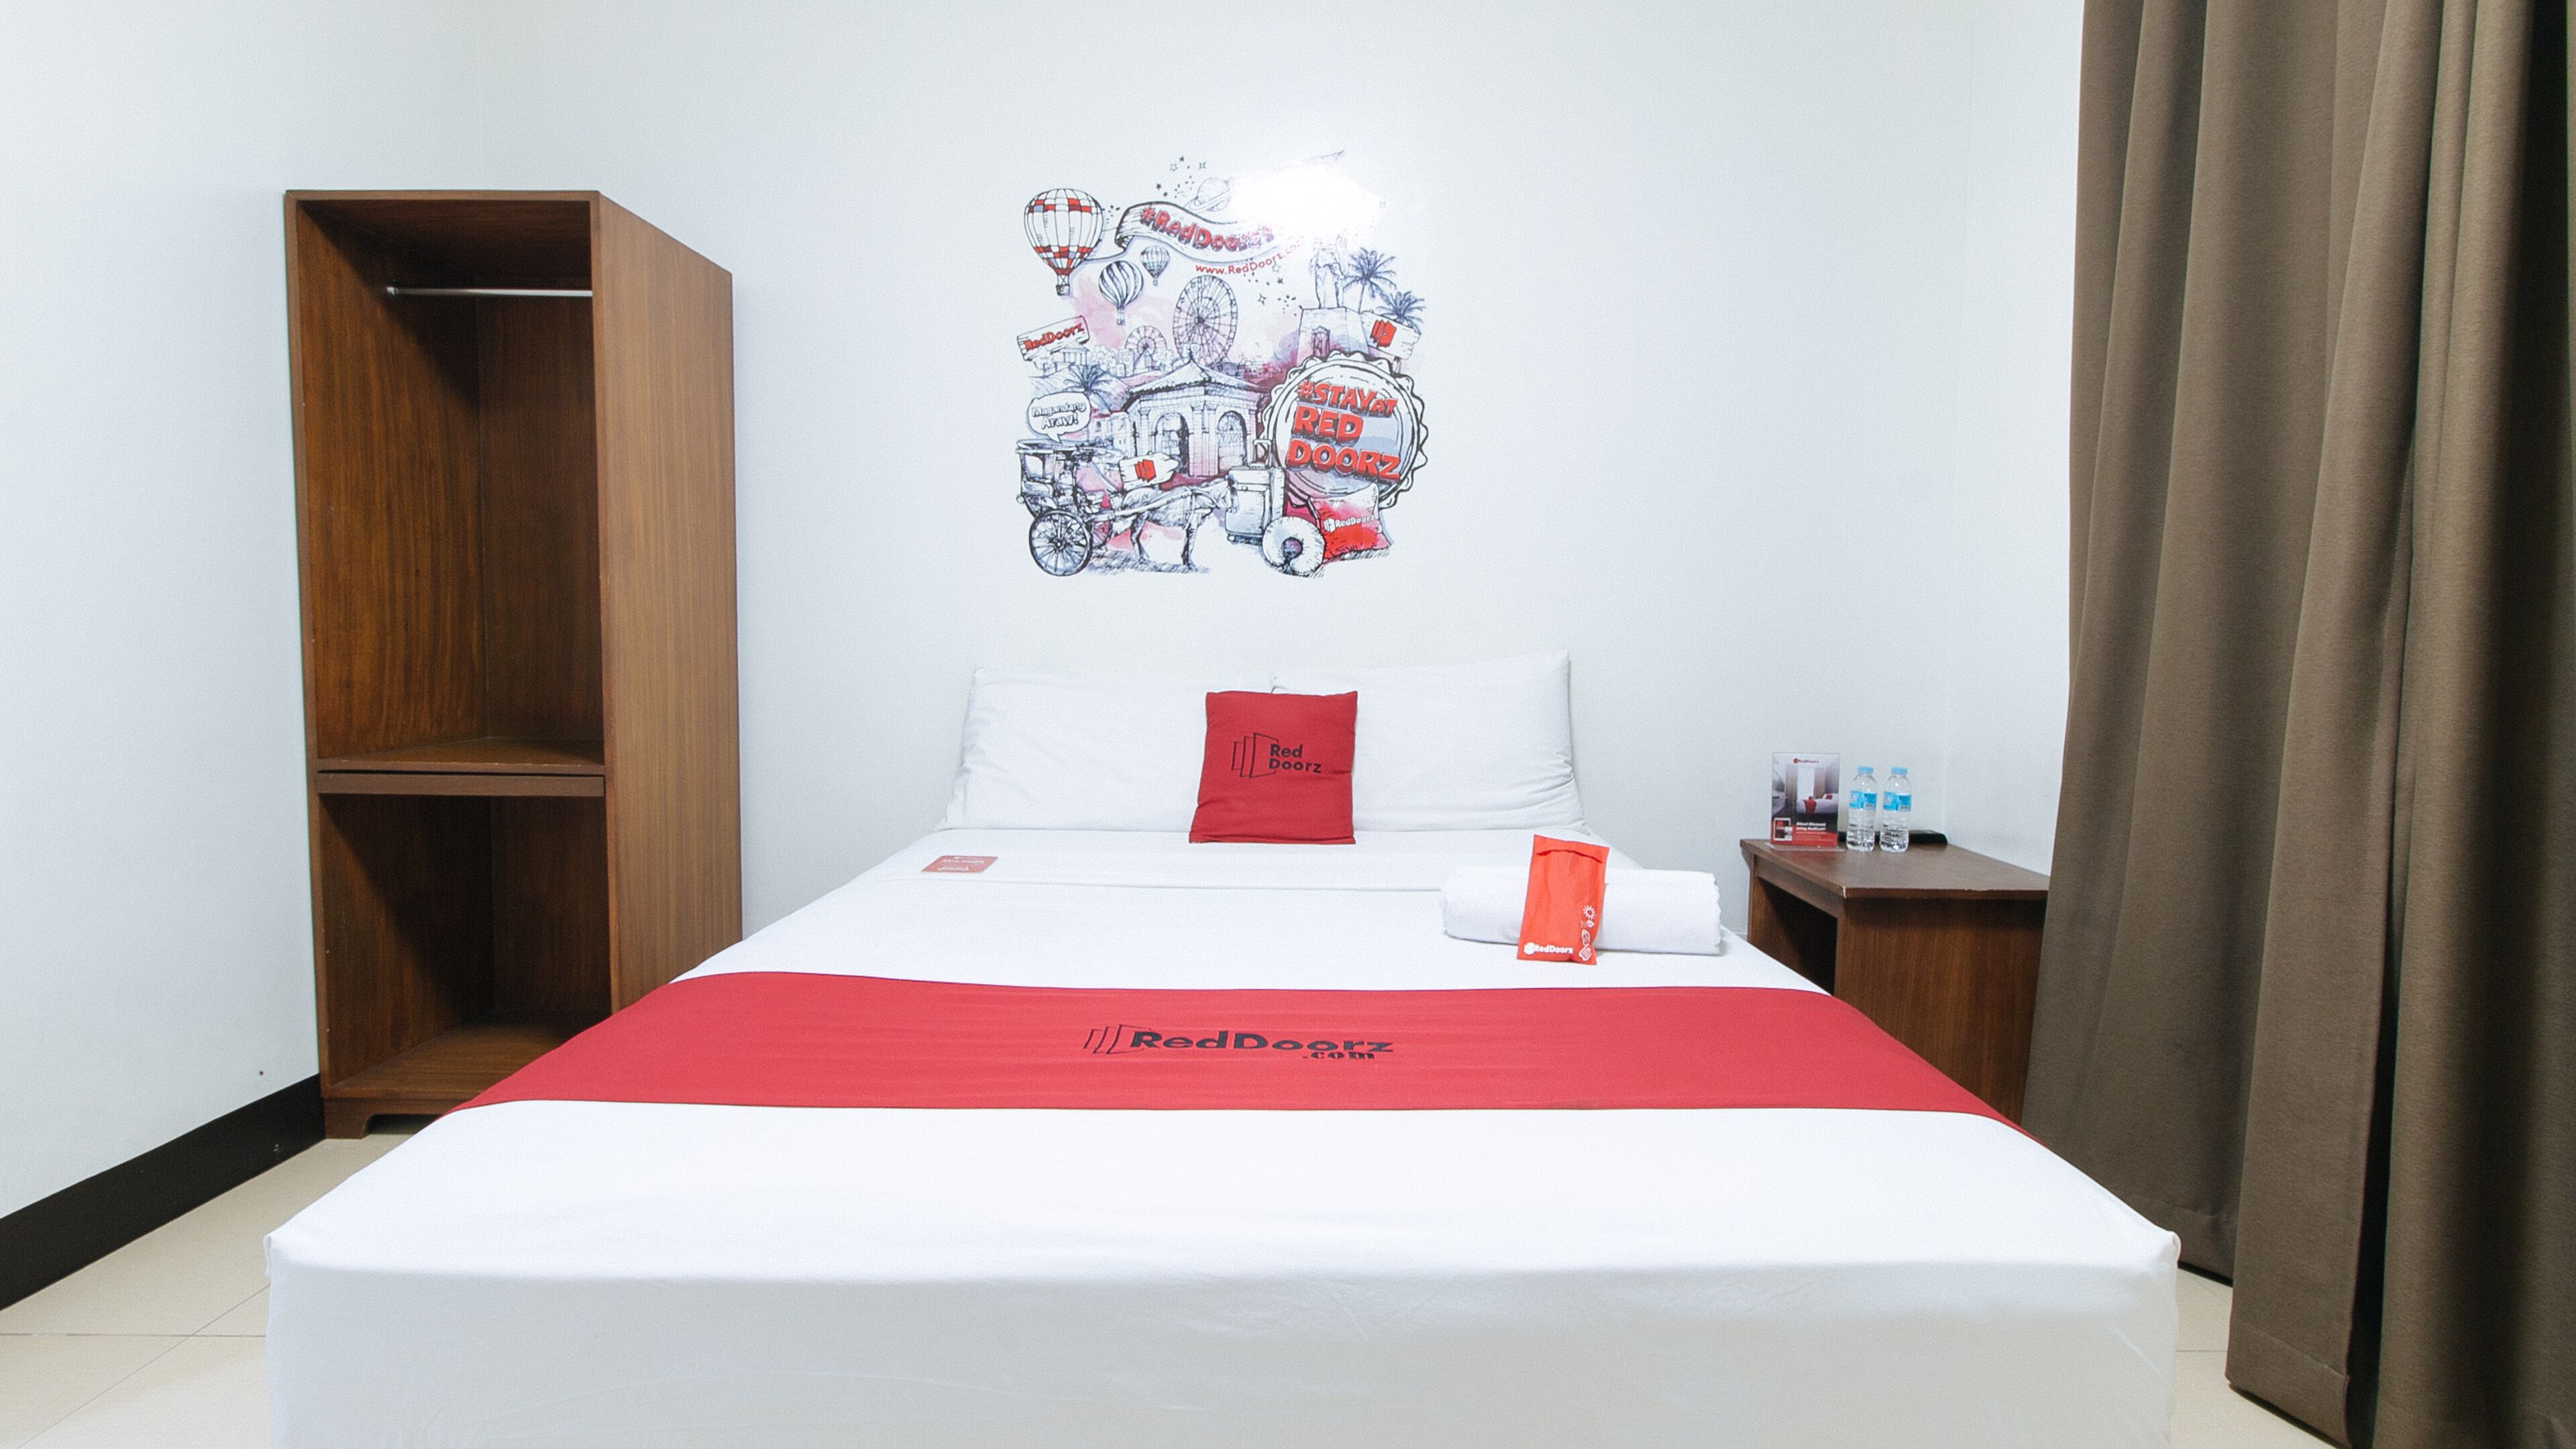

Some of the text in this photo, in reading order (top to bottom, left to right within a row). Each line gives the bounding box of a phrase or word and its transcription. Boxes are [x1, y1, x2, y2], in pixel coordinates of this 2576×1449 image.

[1023, 323, 1085, 352] RedDoorz
[1032, 402, 1087, 417] Magandang
[1041, 411, 1079, 429] Araw!
[1291, 404, 1364, 445] RED
[1285, 438, 1401, 483] DOORZ
[1270, 744, 1303, 758] Red
[1269, 758, 1322, 773] Doorz
[1534, 944, 1574, 954] RedDoorz
[1130, 1031, 1393, 1053] RedDoorz
[1302, 1051, 1375, 1060] .com
